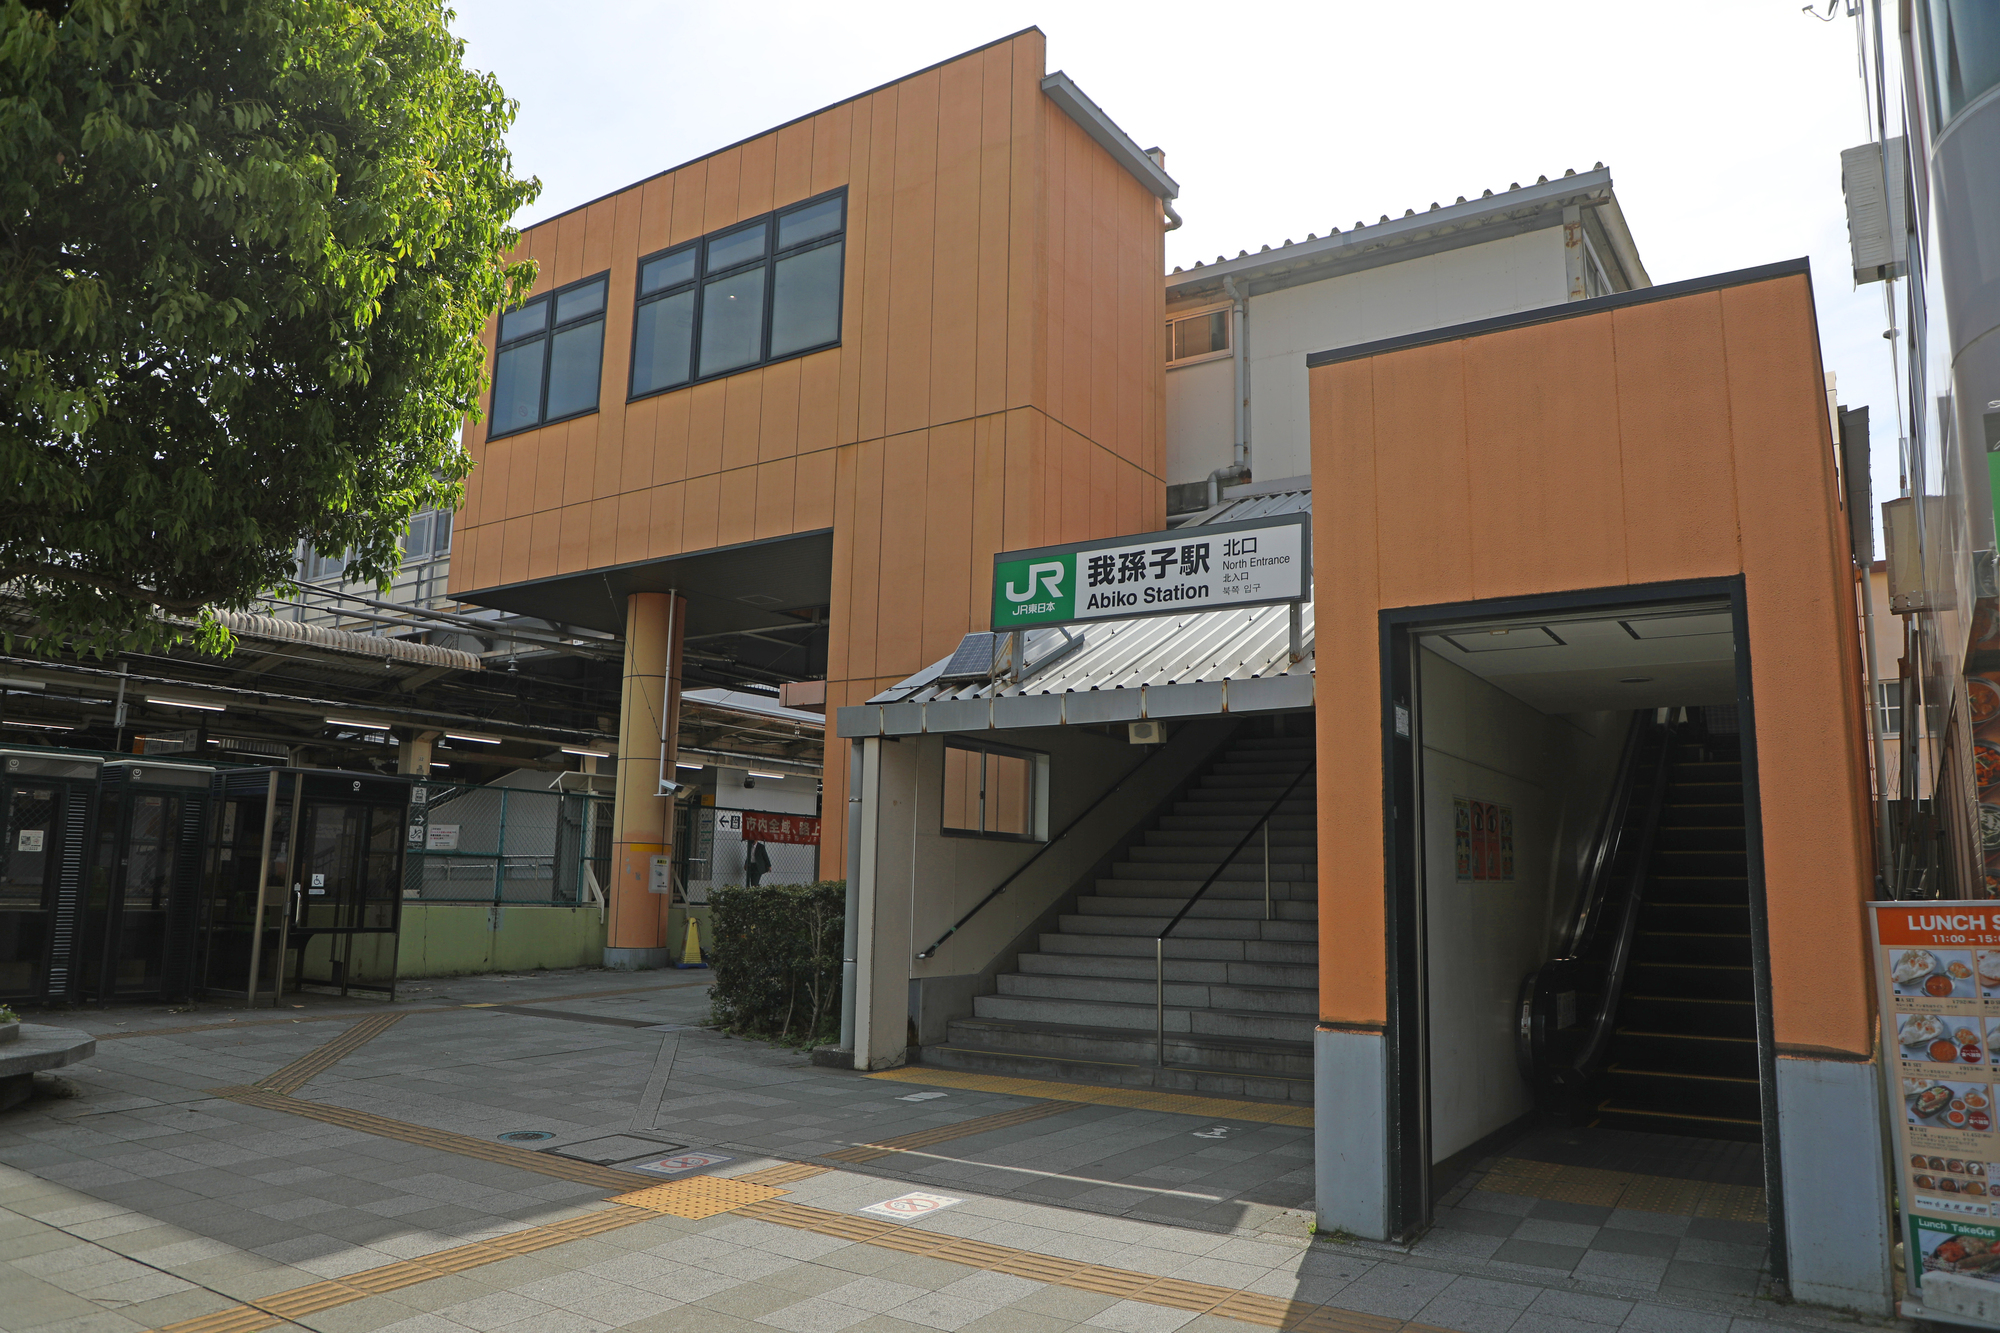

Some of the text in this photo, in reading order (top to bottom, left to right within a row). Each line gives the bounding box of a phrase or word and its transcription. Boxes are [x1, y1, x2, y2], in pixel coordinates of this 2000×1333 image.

[1223, 537, 1257, 557] 北口
[1087, 542, 1210, 588] 我孫子駅
[1222, 555, 1290, 571] North Entrance
[1006, 561, 1065, 602] JR
[1222, 571, 1249, 583] 北入口
[1086, 583, 1209, 610] Abiko Station
[1222, 583, 1261, 595] 북쪽 입구
[1012, 601, 1055, 616] JR東日本
[1907, 914, 1986, 931] LUNCH
[1932, 934, 1966, 943] 11:00
[1977, 934, 2000, 943] 15:
[1918, 1218, 1996, 1237] Lunch TakeOut
